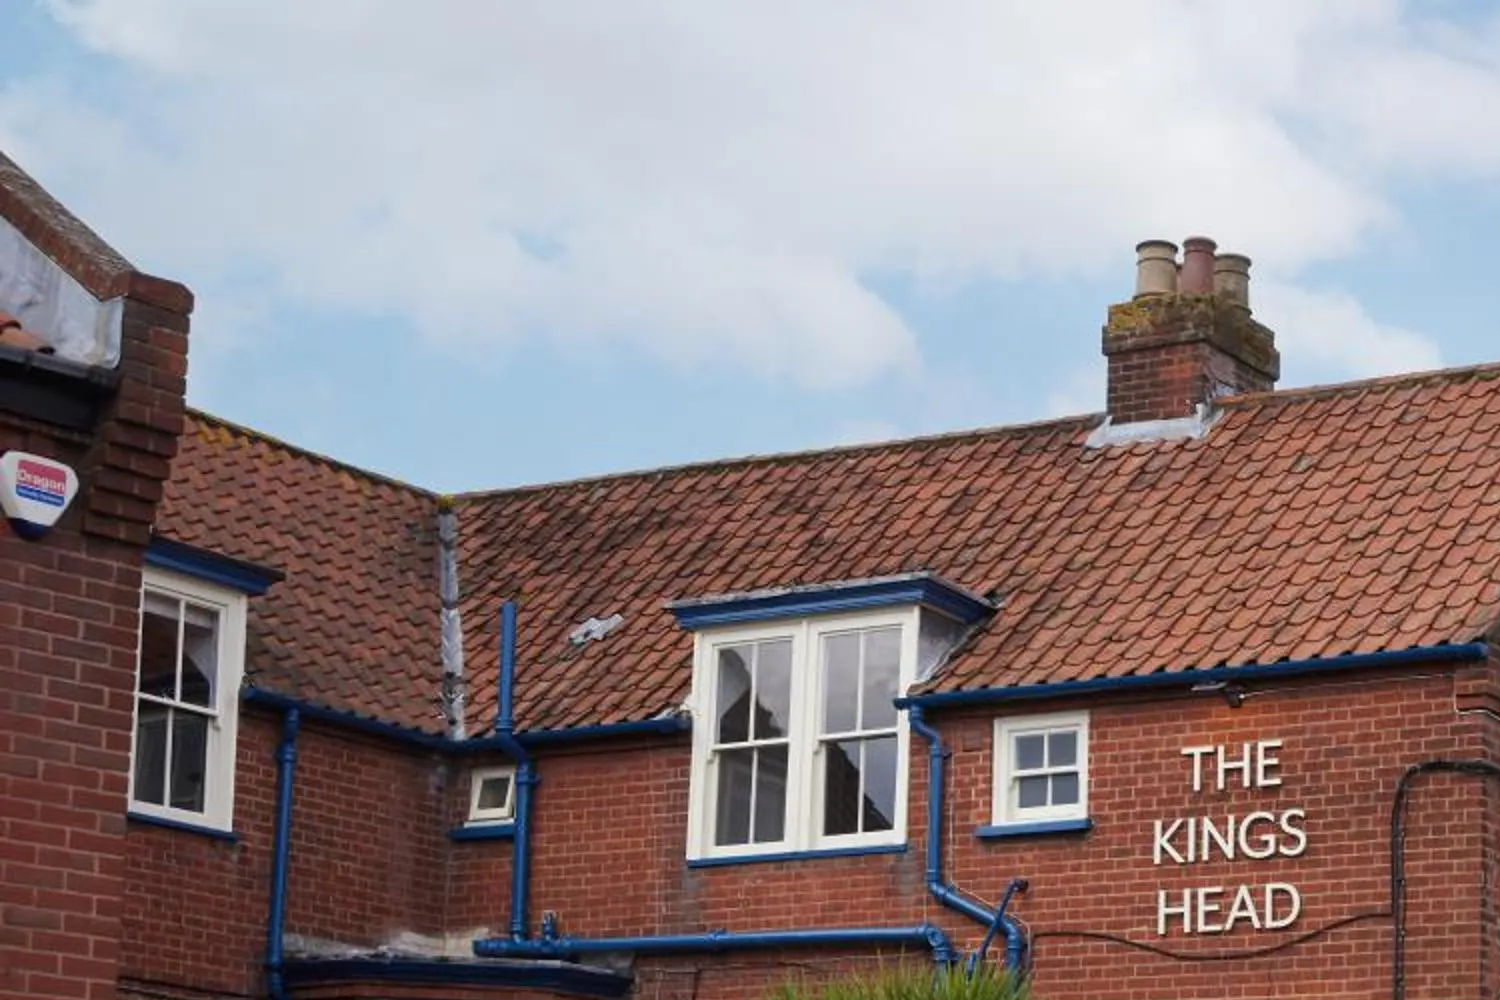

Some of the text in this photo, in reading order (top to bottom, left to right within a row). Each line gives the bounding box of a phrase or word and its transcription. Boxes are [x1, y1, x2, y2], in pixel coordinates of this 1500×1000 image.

[1181, 739, 1282, 791] THE
[1153, 808, 1307, 865] KINGS
[1157, 882, 1300, 935] HEAD
